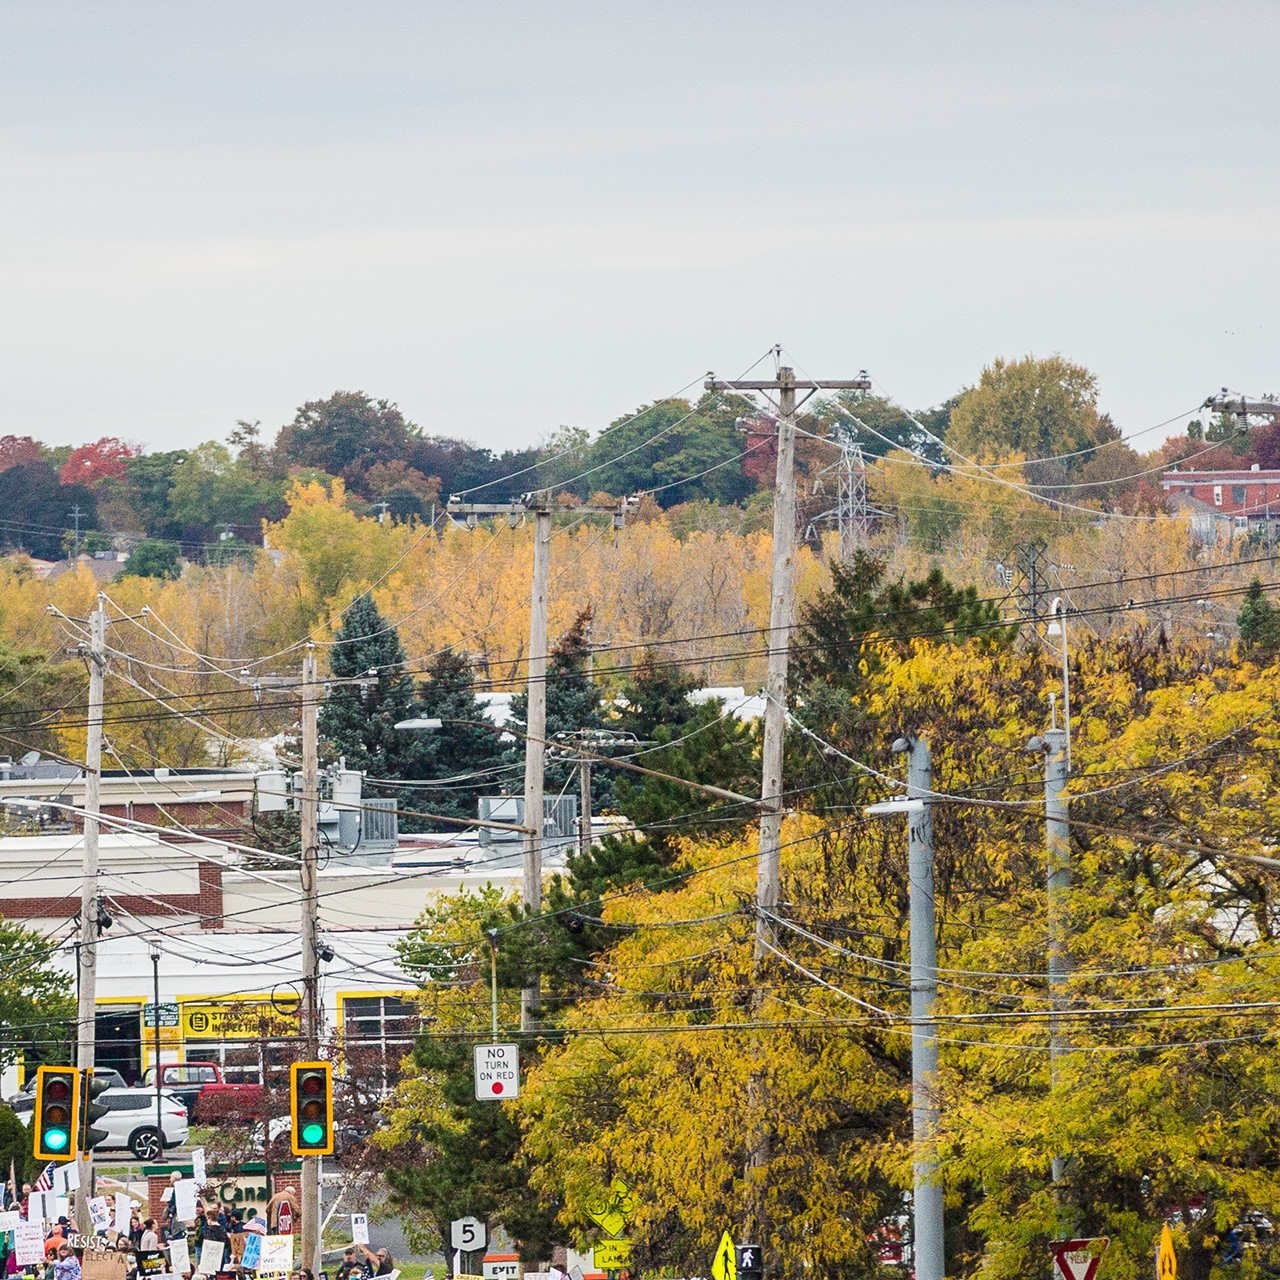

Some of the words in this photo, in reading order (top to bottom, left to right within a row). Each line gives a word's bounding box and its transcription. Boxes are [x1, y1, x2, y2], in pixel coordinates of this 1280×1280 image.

[487, 1048, 505, 1058] NO
[485, 1061, 509, 1069] TURN
[480, 1072, 492, 1080] ON
[497, 1071, 514, 1079] RED
[220, 1182, 268, 1202] Cana
[279, 1214, 292, 1231] STOP
[462, 1224, 475, 1244] 5
[67, 1234, 103, 1248] RESIST
[85, 1252, 114, 1261] ELECT
[118, 1255, 125, 1263] A
[492, 1266, 516, 1275] EXIT
